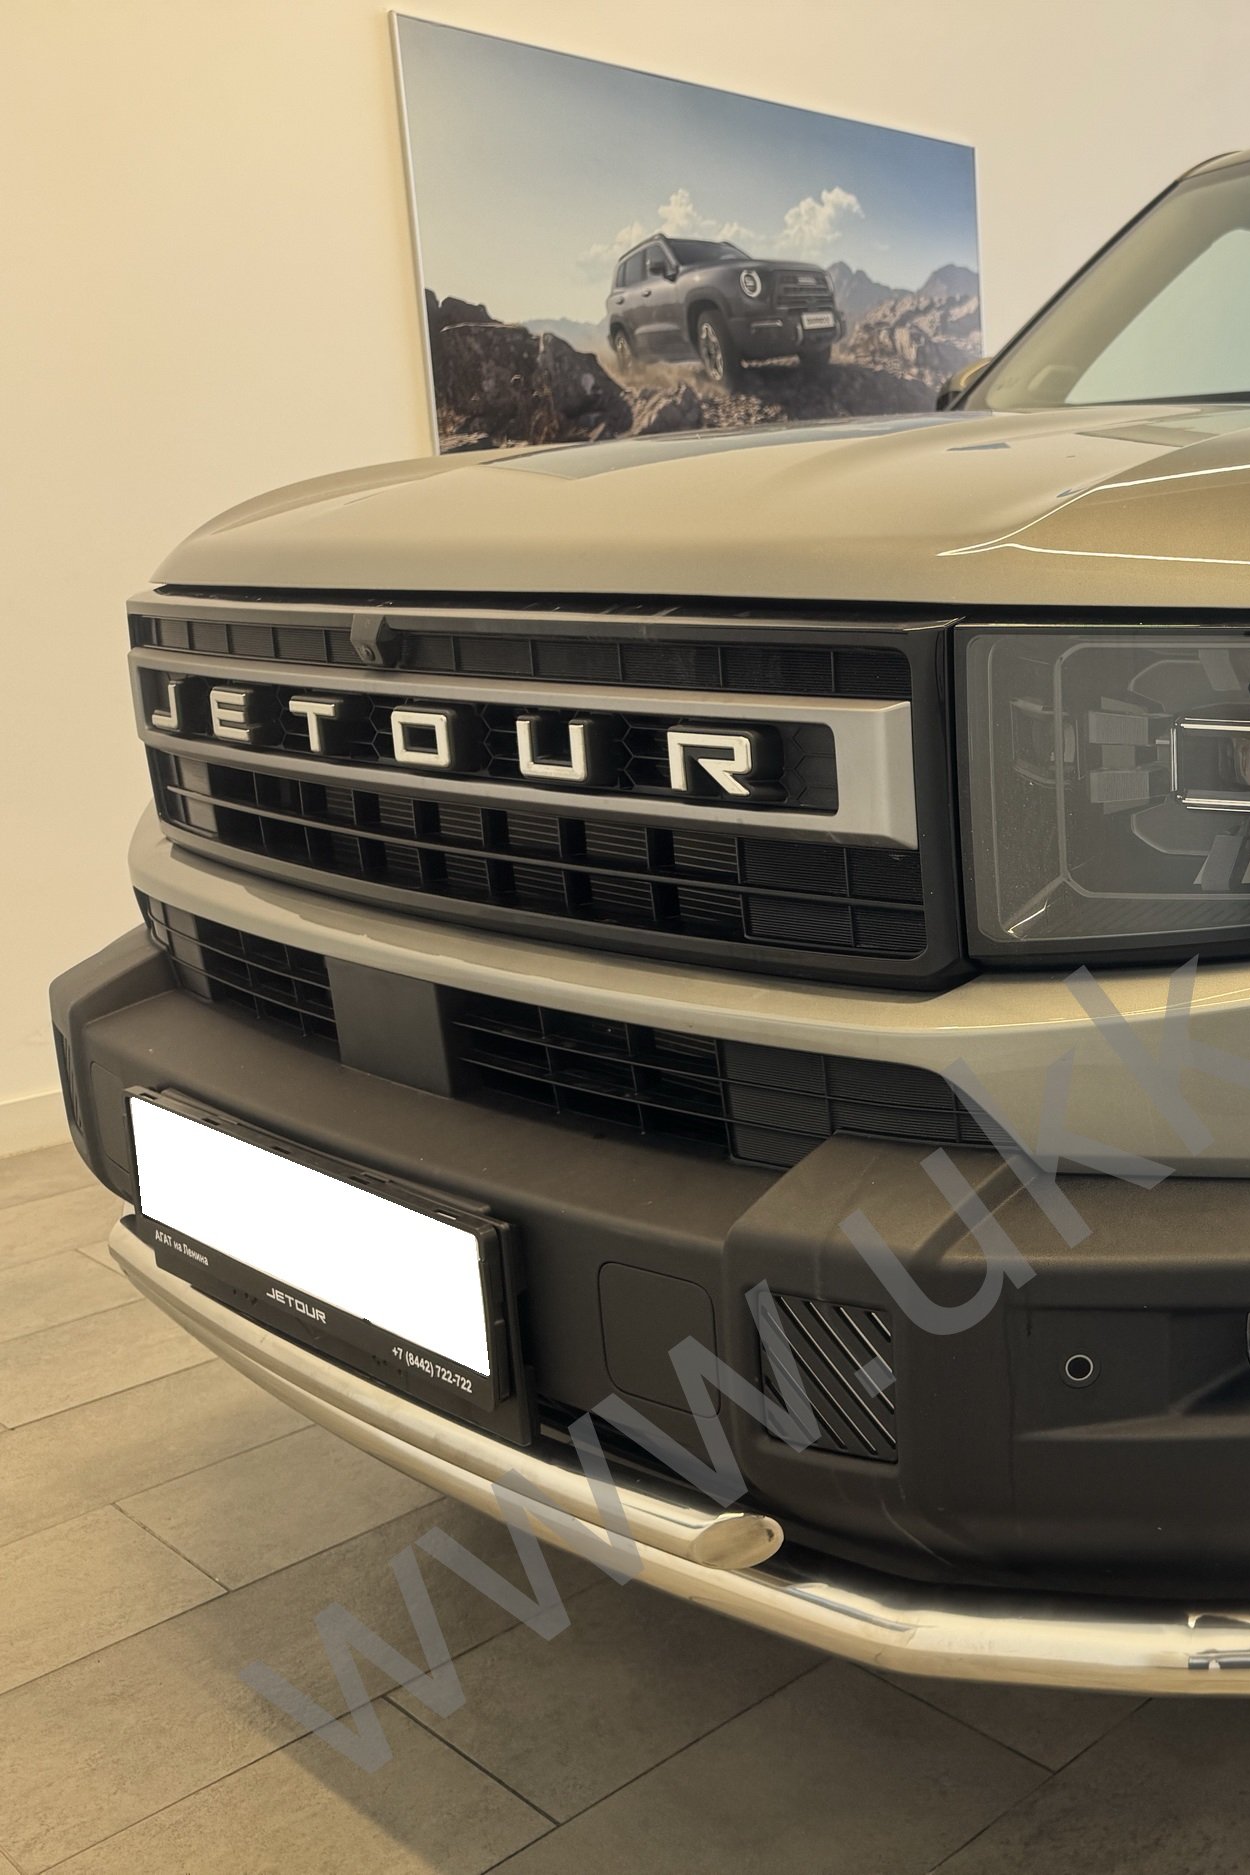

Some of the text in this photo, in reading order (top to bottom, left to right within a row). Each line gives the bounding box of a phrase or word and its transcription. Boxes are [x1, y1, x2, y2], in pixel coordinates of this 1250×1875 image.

[151, 679, 752, 797] JETOUR
[155, 1229, 172, 1247] АГАТ
[173, 1240, 183, 1253] на
[266, 1287, 327, 1324] JETOUR
[392, 1346, 473, 1394] +7 (8442) 722-722
